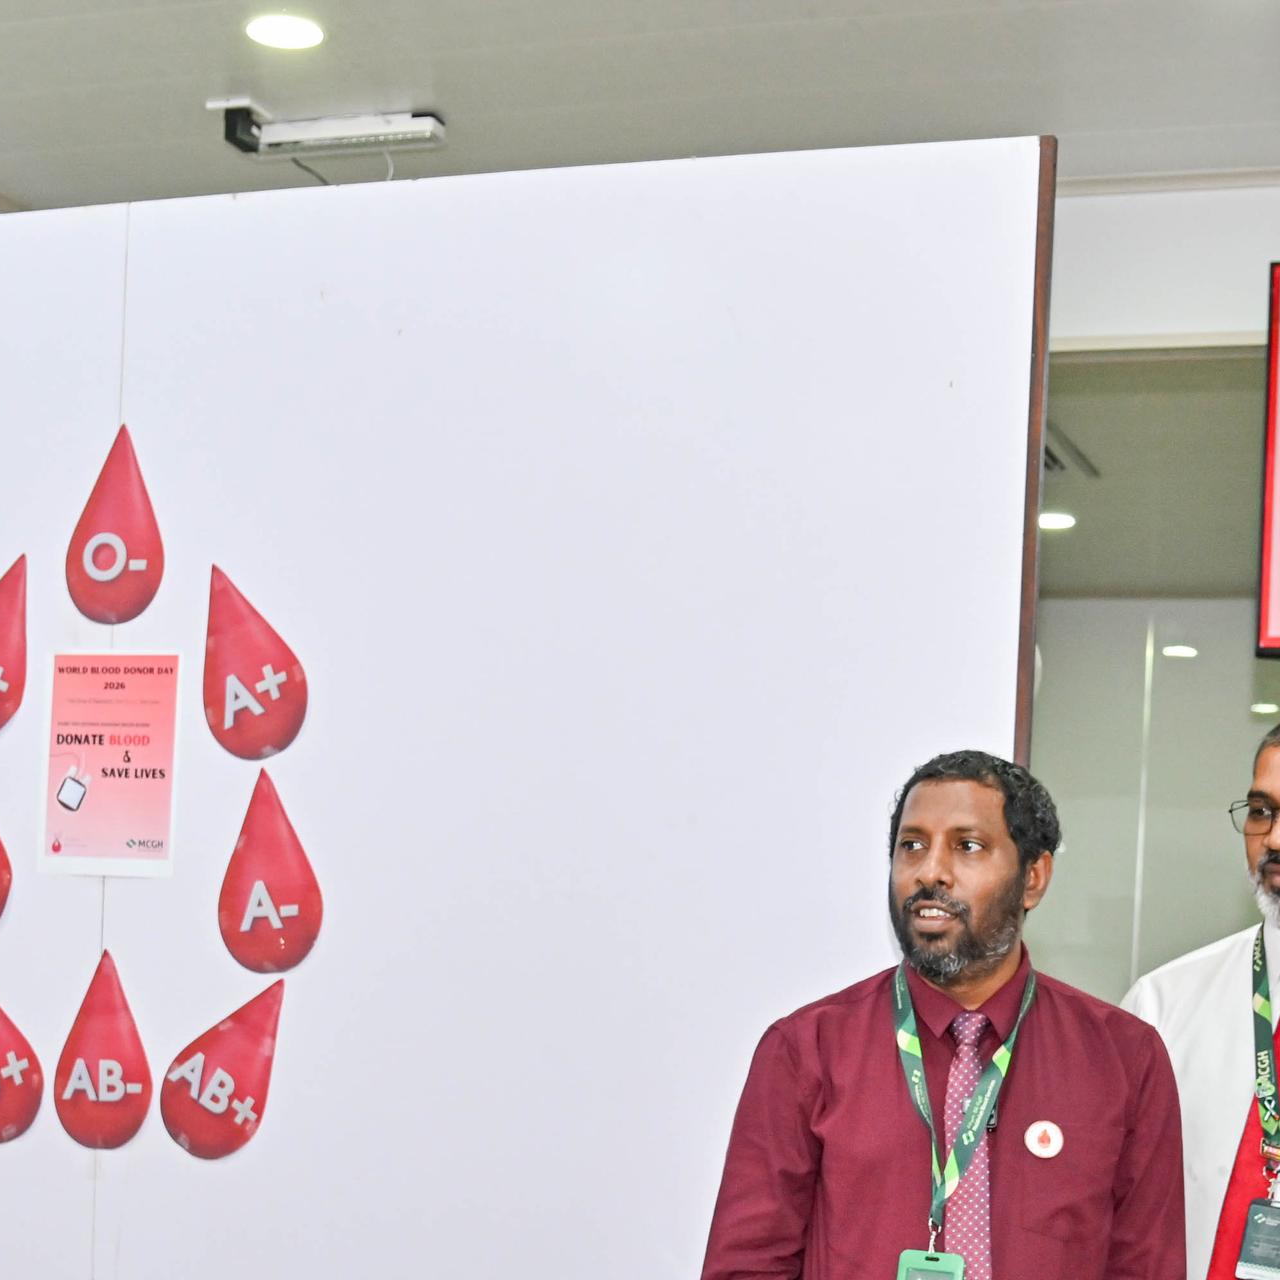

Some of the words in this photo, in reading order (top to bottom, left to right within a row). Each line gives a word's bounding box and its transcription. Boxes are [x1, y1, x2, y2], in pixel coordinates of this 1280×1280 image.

[82, 532, 148, 583] O-
[58, 666, 89, 675] WORLD
[90, 666, 121, 675] BLOOD
[123, 667, 154, 675] DONOR
[157, 667, 175, 675] DAY
[103, 682, 126, 690] 2026
[223, 663, 288, 730] A+
[56, 734, 105, 746] DONATE
[109, 735, 150, 747] BLOOD
[101, 767, 131, 779] SAVE
[134, 768, 166, 779] LIVES
[138, 839, 164, 849] MCGH
[239, 880, 300, 932] A-
[61, 1057, 142, 1102] AB-
[167, 1051, 259, 1126] AB+
